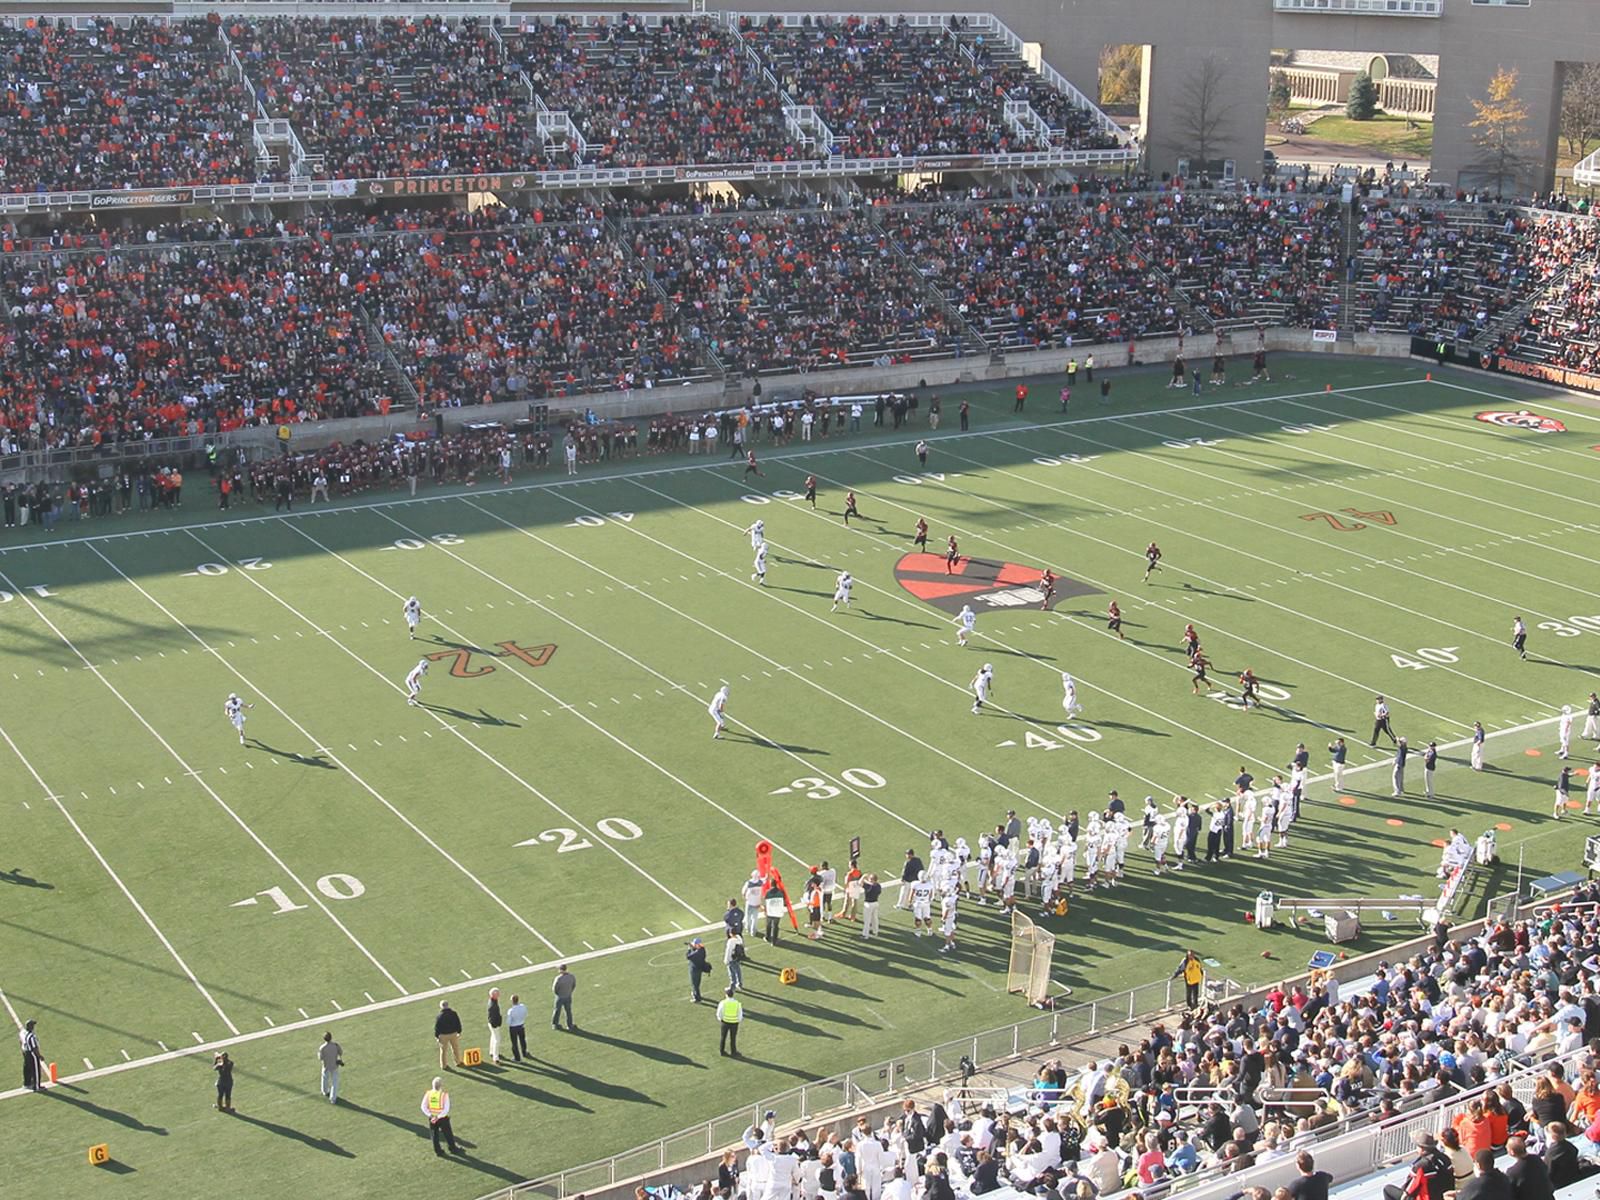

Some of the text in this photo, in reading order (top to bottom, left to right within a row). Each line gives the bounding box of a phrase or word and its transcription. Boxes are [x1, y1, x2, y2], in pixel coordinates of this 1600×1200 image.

[394, 177, 501, 194] PRINCETON
[1498, 357, 1563, 383] PRINCETON
[1390, 647, 1459, 671] 40
[1025, 724, 1102, 750] 40
[791, 768, 887, 799] 30
[539, 817, 643, 852] 20
[256, 873, 365, 915] 10
[467, 1050, 479, 1064] 10
[95, 1147, 105, 1161] G
